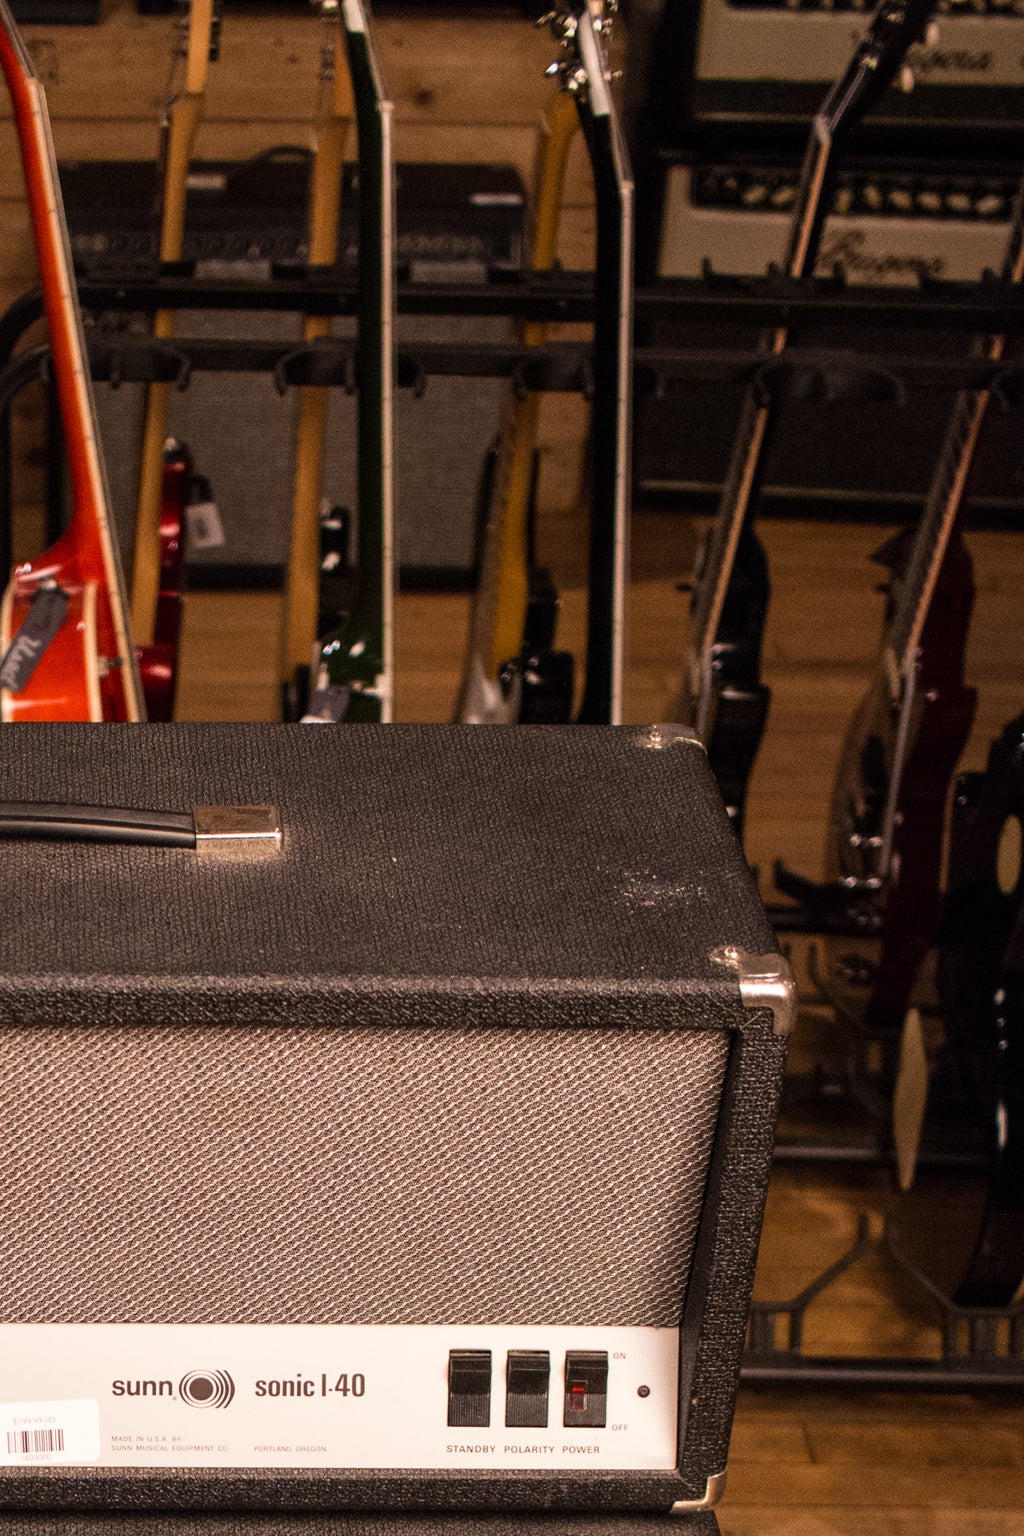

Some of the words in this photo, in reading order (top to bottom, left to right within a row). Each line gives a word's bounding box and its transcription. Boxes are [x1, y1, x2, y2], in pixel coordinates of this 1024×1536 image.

[612, 1351, 627, 1360] ON
[111, 1379, 173, 1398] sunn
[255, 1373, 315, 1397] sonic
[611, 1423, 629, 1432] OFF
[111, 1444, 133, 1452] SUNN
[135, 1444, 168, 1452] MUSICAL
[171, 1444, 214, 1452] EQUIPMENT
[295, 1445, 327, 1453] OREGON
[446, 1444, 496, 1455] STANDBY
[503, 1444, 555, 1455] POLARITY
[561, 1444, 601, 1455] POWER
